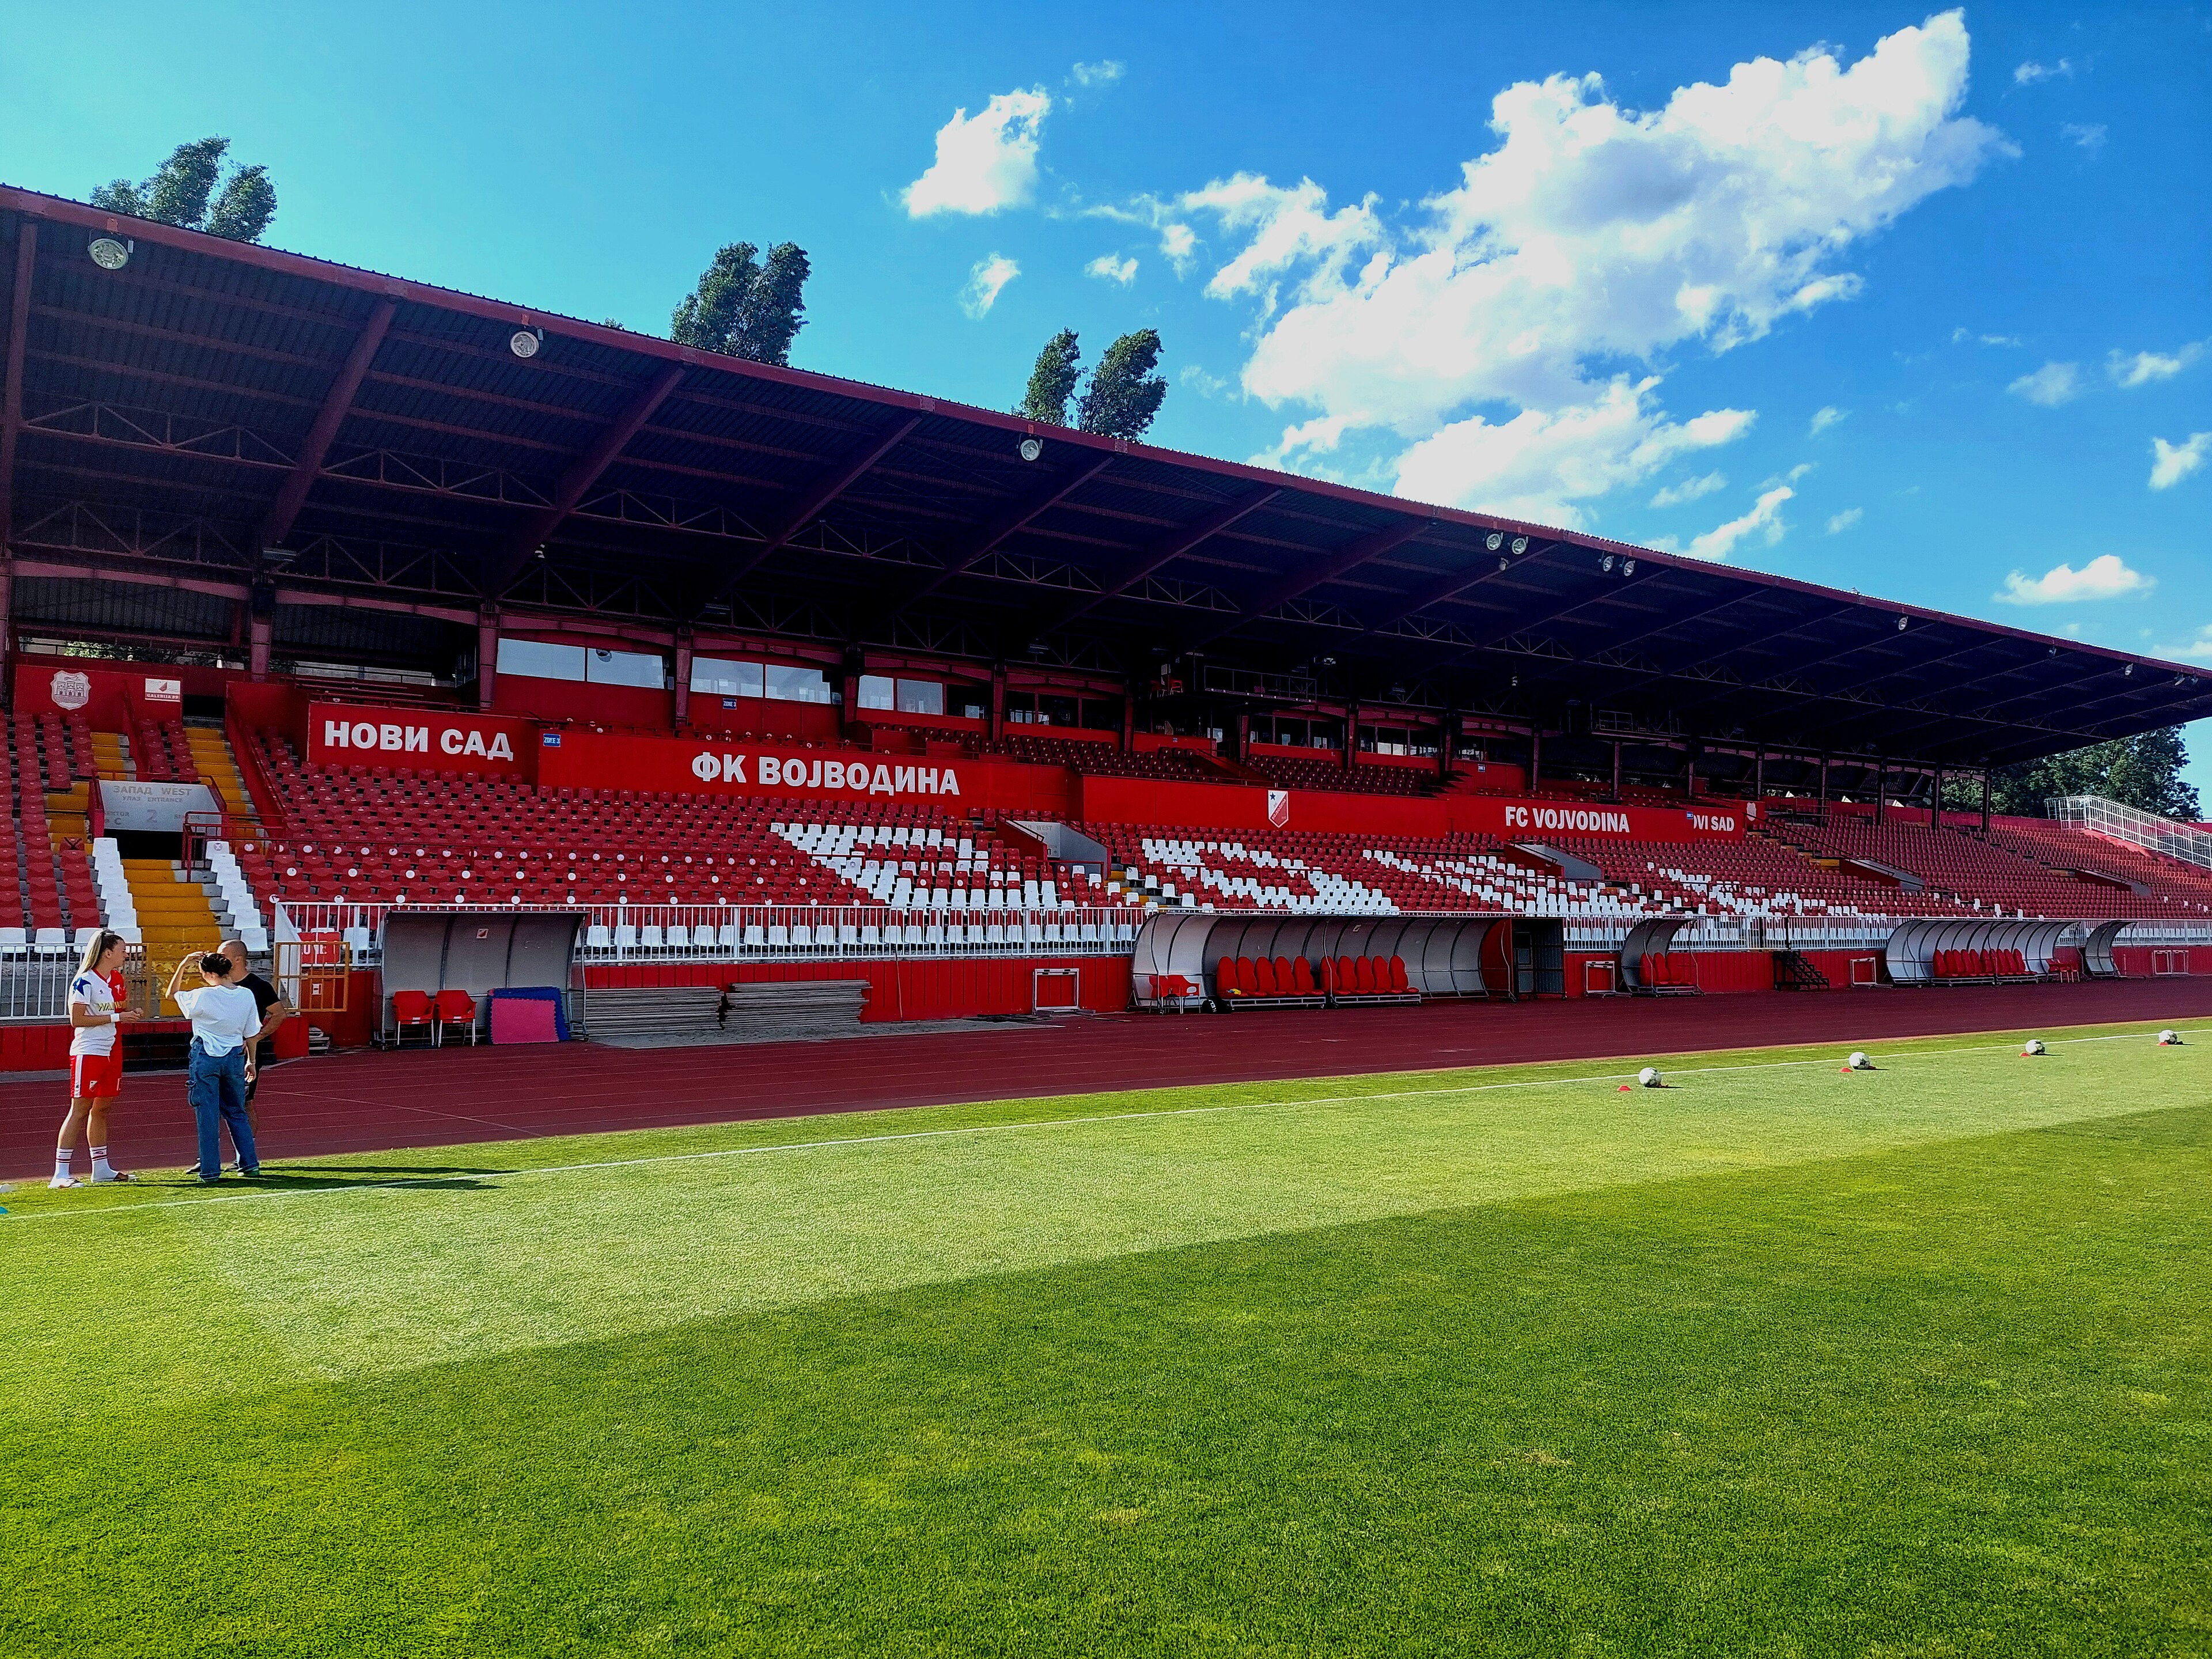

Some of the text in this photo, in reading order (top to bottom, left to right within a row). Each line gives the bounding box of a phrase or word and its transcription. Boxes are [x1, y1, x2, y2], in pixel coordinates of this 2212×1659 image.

[325, 720, 514, 762] НОВИ САД
[692, 752, 960, 796] ФК ВОЈВОДИНА
[113, 785, 192, 796] ЗАПАД WEST
[146, 809, 158, 823] 2
[1505, 806, 1630, 833] FC VOJVODINA
[1711, 816, 1734, 831] SAD
